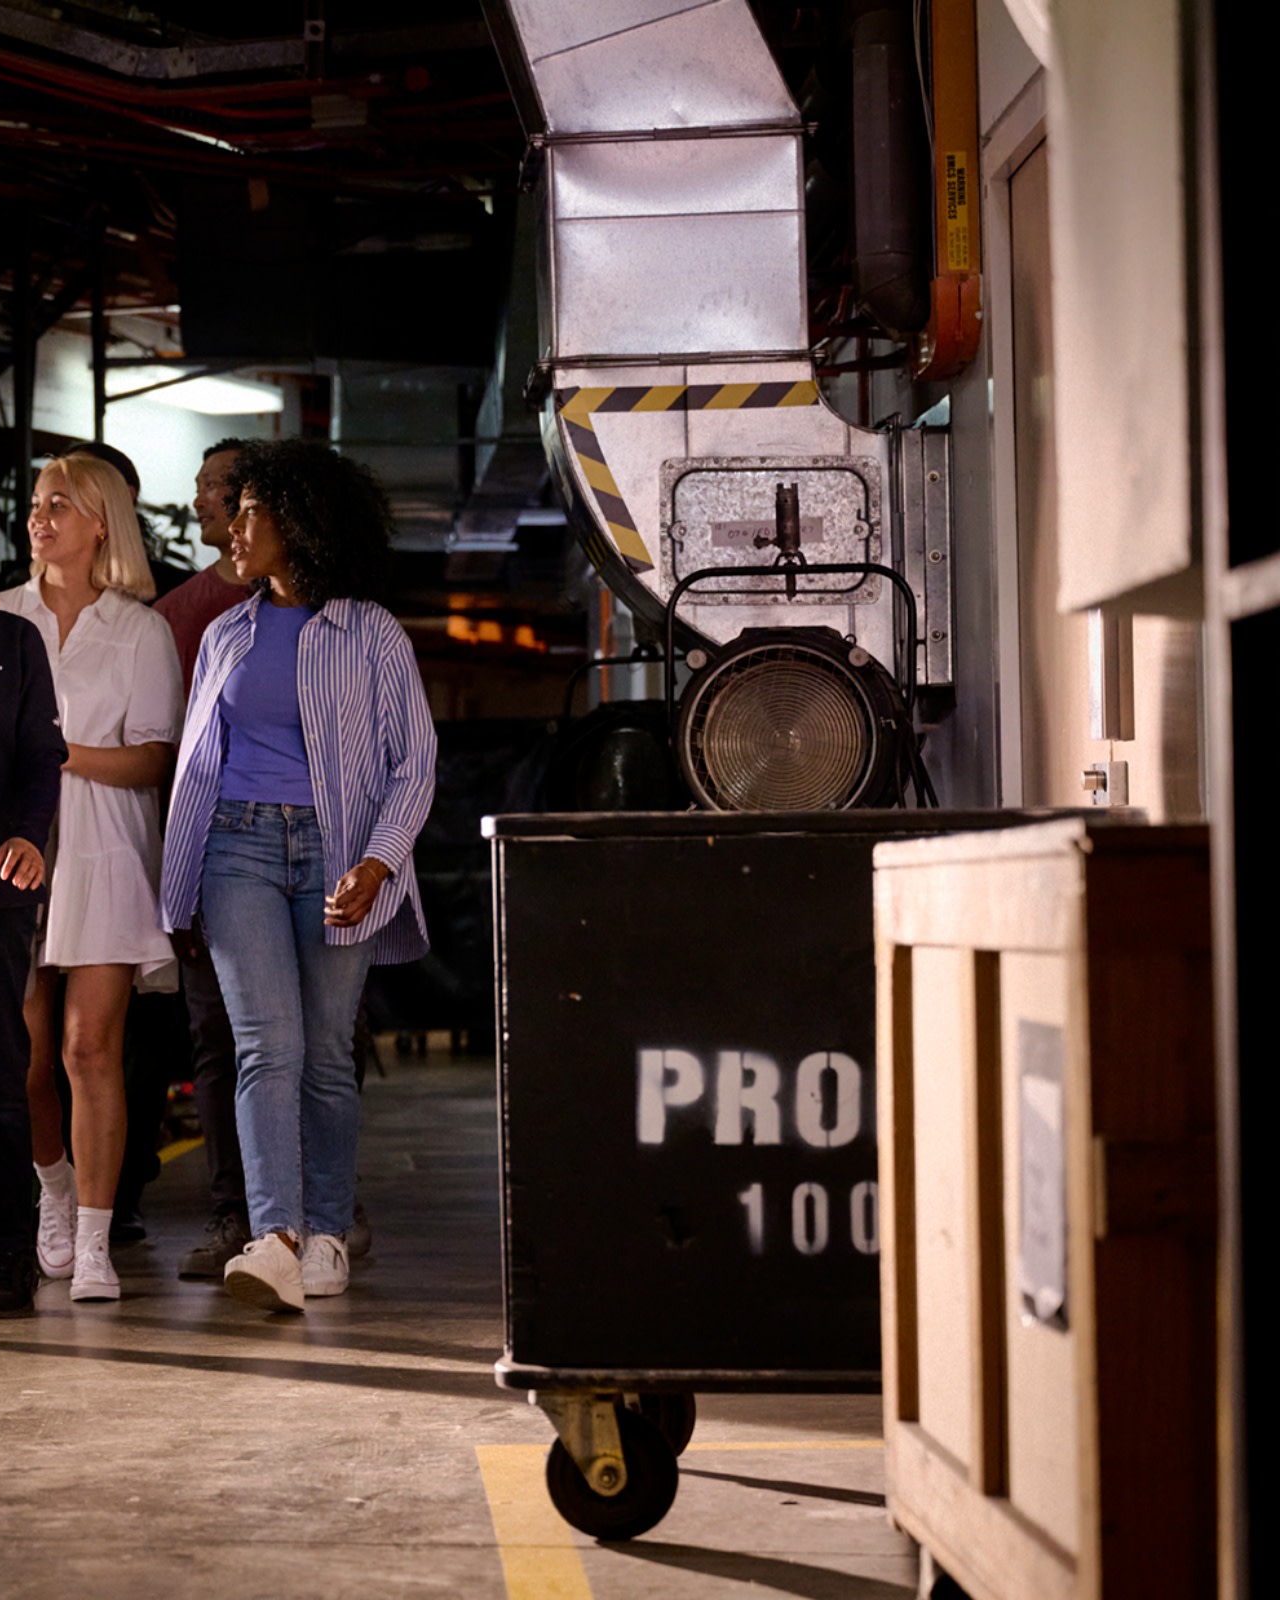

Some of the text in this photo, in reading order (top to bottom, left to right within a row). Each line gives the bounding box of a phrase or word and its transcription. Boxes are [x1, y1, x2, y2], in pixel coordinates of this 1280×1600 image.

[947, 181, 957, 219] SERVICES
[957, 167, 966, 206] WARNING
[737, 1180, 880, 1254] 100
